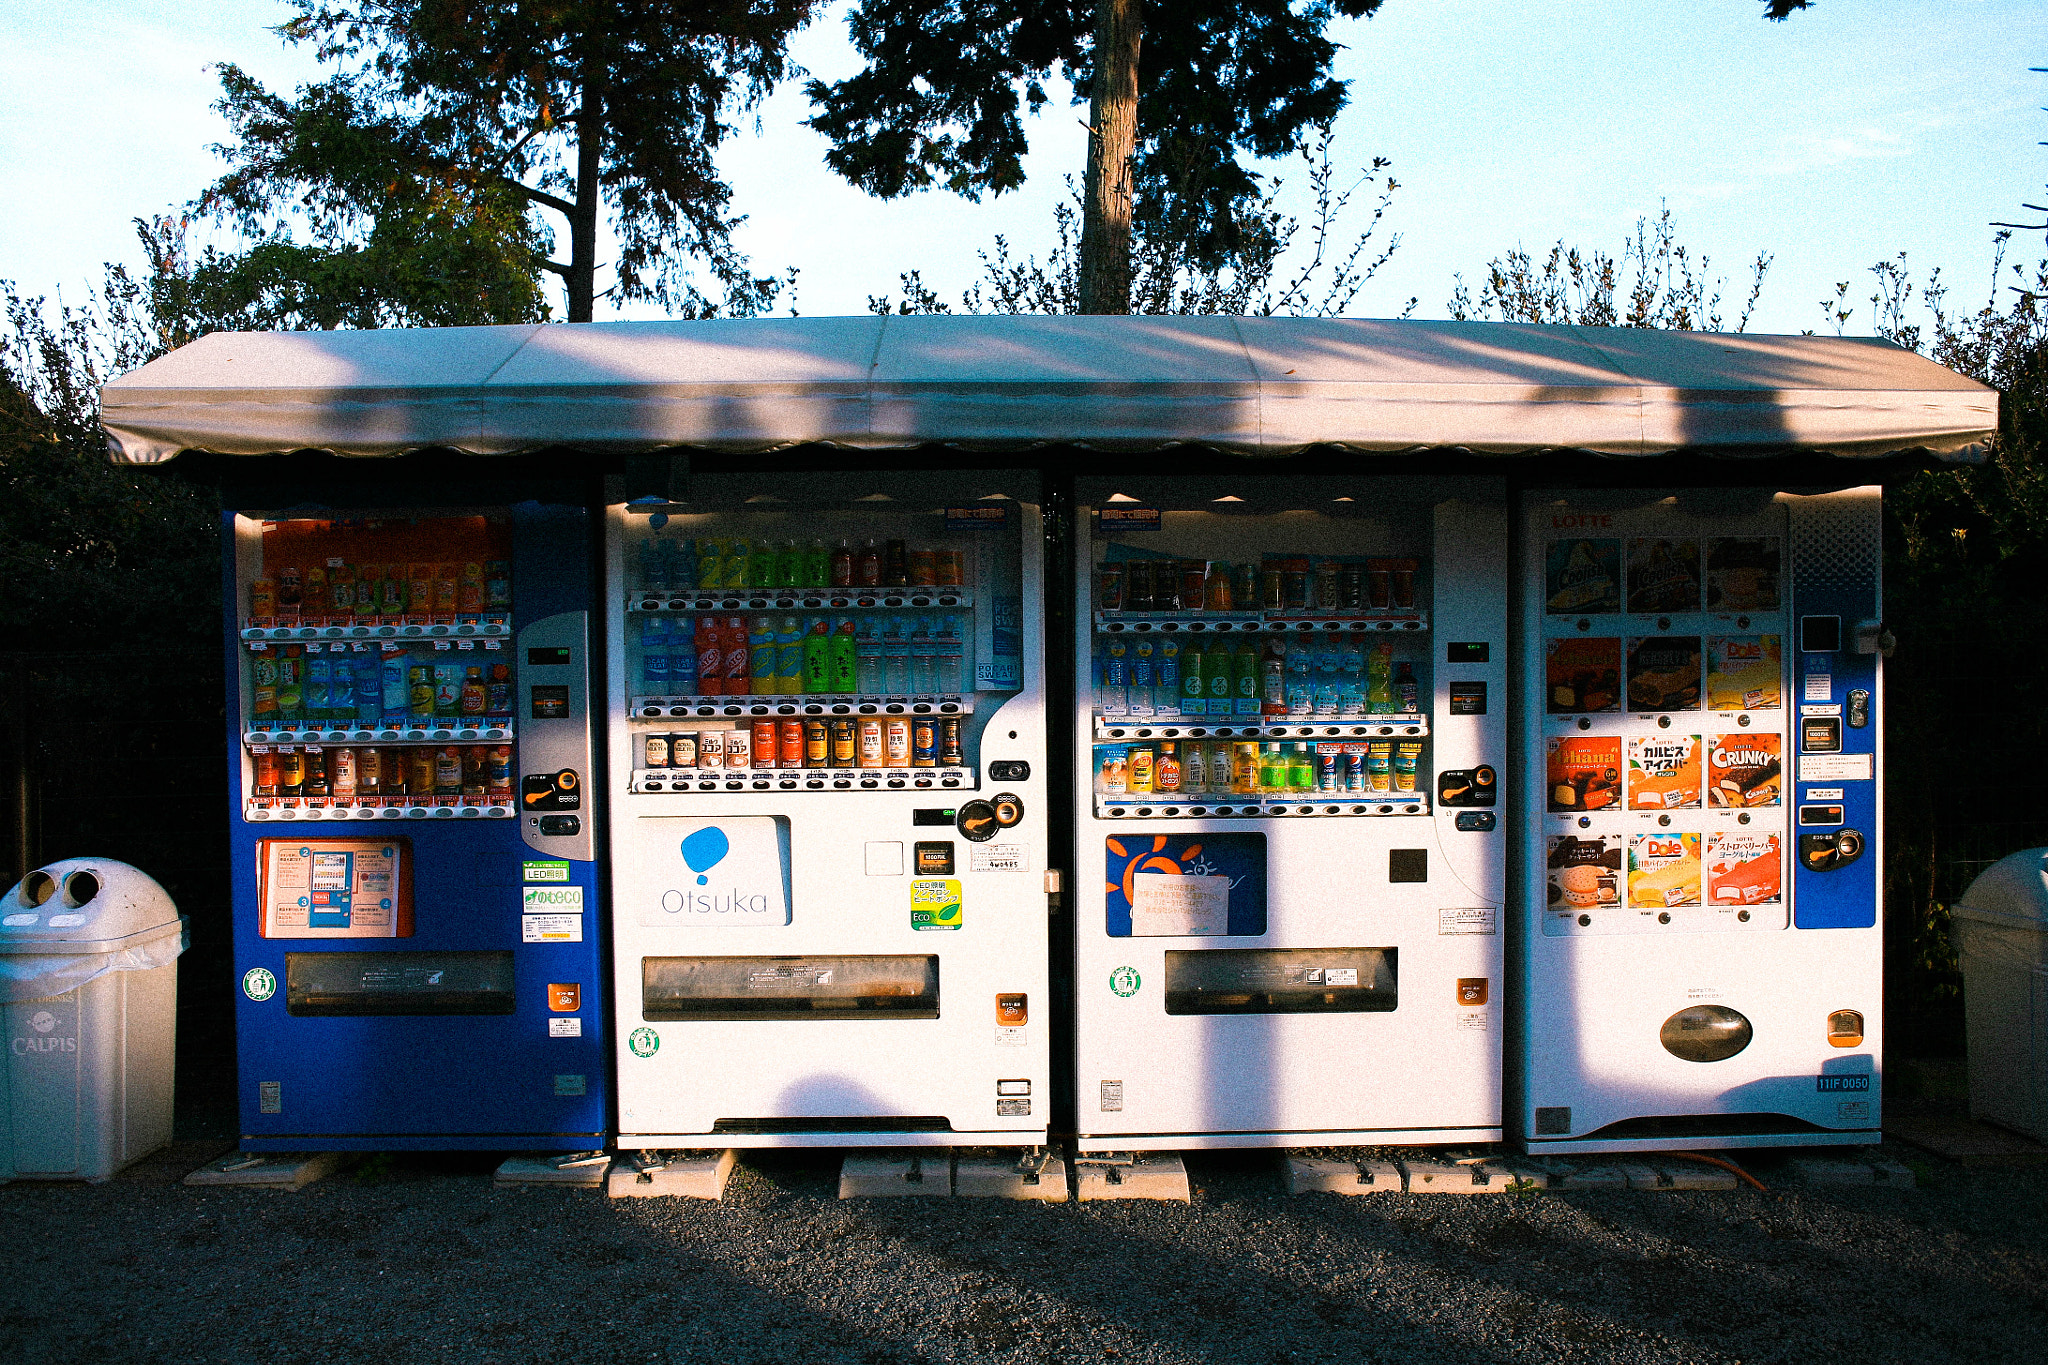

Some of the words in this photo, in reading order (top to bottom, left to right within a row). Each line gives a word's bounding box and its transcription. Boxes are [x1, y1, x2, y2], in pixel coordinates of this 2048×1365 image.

[1552, 515, 1612, 528] LOTTE
[1727, 642, 1761, 657] Dole
[701, 744, 721, 753] ココア
[727, 745, 747, 754] ココア
[1644, 746, 1684, 758] カルピス
[1556, 750, 1616, 763] Ghana
[1711, 747, 1774, 768] CRUNKY
[1644, 758, 1688, 770] アイスバー
[1648, 840, 1682, 856] Dole
[1720, 842, 1775, 851] ストロベリーバー
[528, 870, 564, 878] LED照明
[301, 898, 307, 906] 3
[662, 888, 767, 913] Otsuka
[913, 913, 930, 921] Eco
[12, 1037, 76, 1055] CALPIS
[1842, 1078, 1868, 1089] 0050
